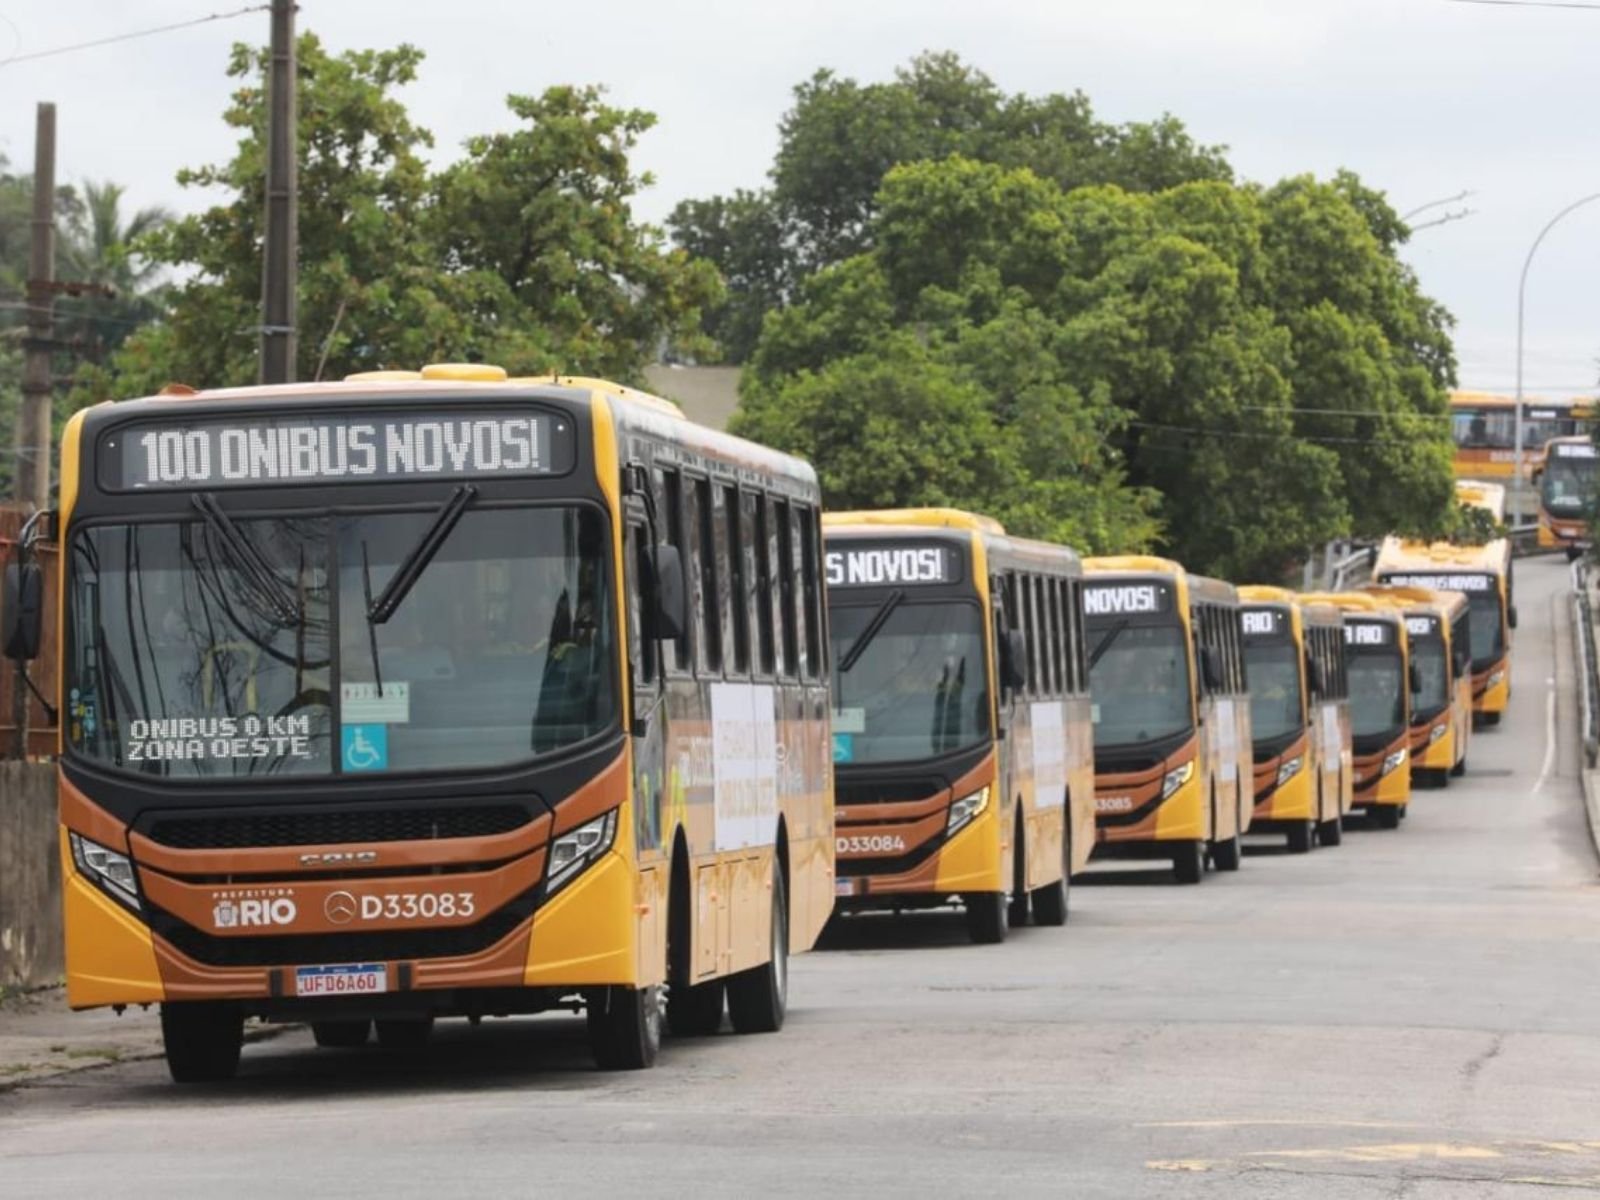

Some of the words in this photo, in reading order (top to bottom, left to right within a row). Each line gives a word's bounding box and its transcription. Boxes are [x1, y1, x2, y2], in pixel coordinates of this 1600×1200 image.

[141, 430, 211, 482] 100
[220, 424, 377, 479] ONIBUS
[386, 419, 540, 473] NOVOS!
[848, 548, 942, 583] NOVOS!
[1083, 585, 1155, 614] NOVOS!
[130, 717, 238, 739] ONIBUS
[245, 716, 260, 736] 0
[267, 715, 309, 735] KM
[128, 740, 204, 760] ZONA
[211, 736, 309, 758] OESTE
[836, 836, 904, 853] D33084
[240, 899, 296, 926] RIO
[361, 893, 475, 919] D33083
